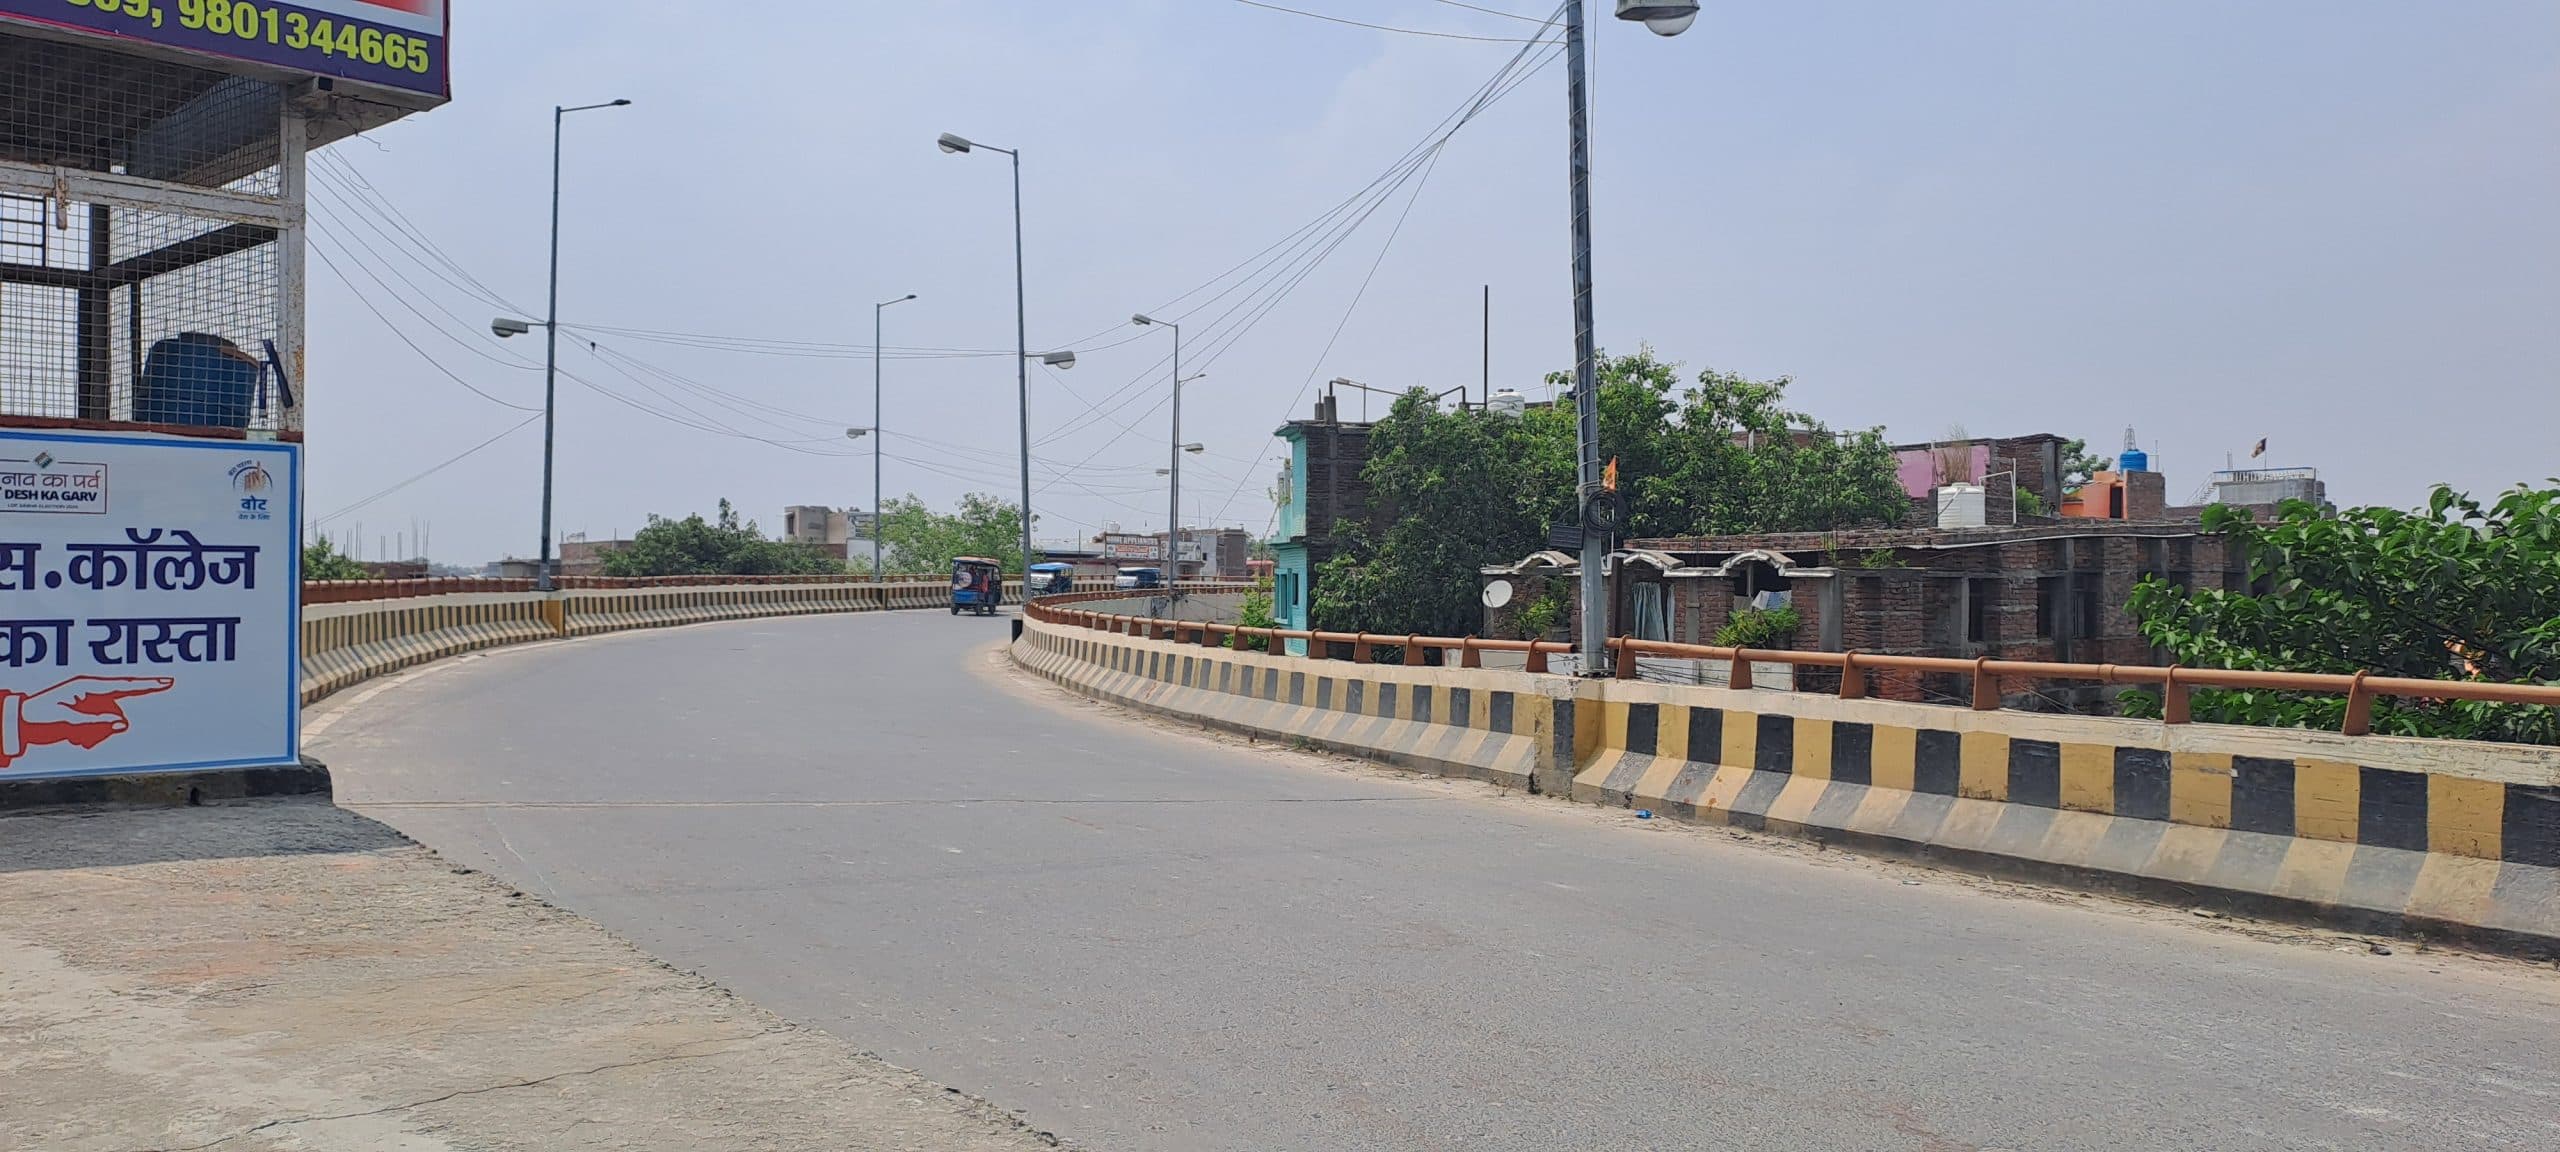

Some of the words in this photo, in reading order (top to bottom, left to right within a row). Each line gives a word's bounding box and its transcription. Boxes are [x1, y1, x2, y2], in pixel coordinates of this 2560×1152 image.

[179, 0, 430, 72] 9801344665
[41, 473, 69, 488] का
[73, 470, 101, 489] पर्व
[5, 489, 39, 501] DESH
[41, 490, 60, 501] KA
[61, 491, 98, 502] GARV
[241, 495, 268, 511] वोट
[0, 617, 75, 668] का
[87, 616, 241, 665] रास्ता
